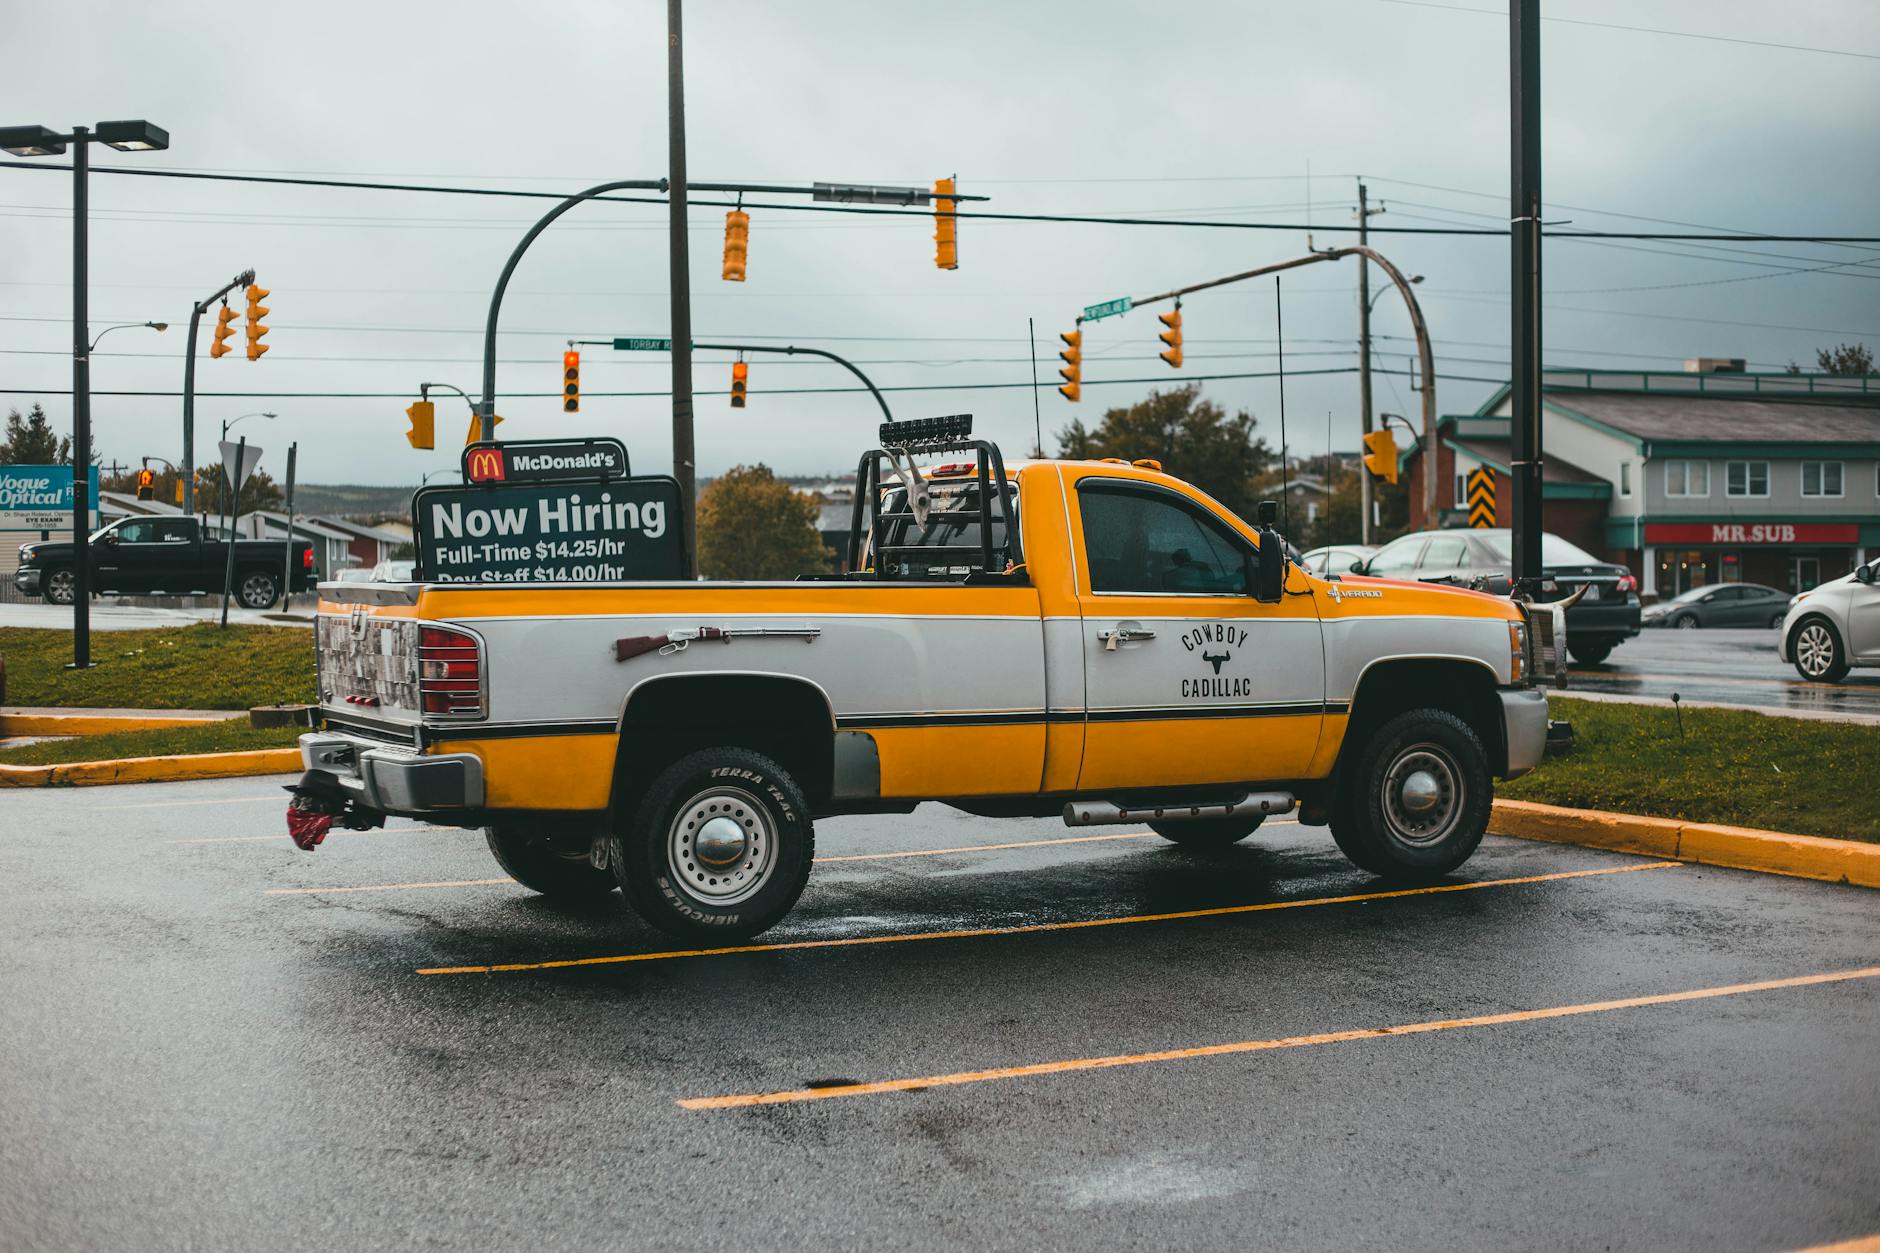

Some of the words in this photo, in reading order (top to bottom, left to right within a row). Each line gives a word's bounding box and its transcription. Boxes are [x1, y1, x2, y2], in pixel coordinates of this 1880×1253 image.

[630, 340, 661, 349] TORBAY
[512, 453, 614, 471] McDonald's
[0, 474, 50, 494] Vogue
[0, 489, 62, 508] Optical
[432, 502, 528, 539] Now
[538, 492, 666, 538] Hiring
[436, 542, 532, 565] Full-Time
[536, 538, 626, 562] $14.25/hr
[480, 568, 530, 582] Staff
[534, 564, 624, 582] $14.00/hr
[1182, 624, 1248, 651] COWBOY
[1182, 678, 1250, 698] CADILLAC
[710, 767, 763, 784] TERRA
[767, 784, 796, 823] TRAC
[656, 876, 740, 926] HERCULES
